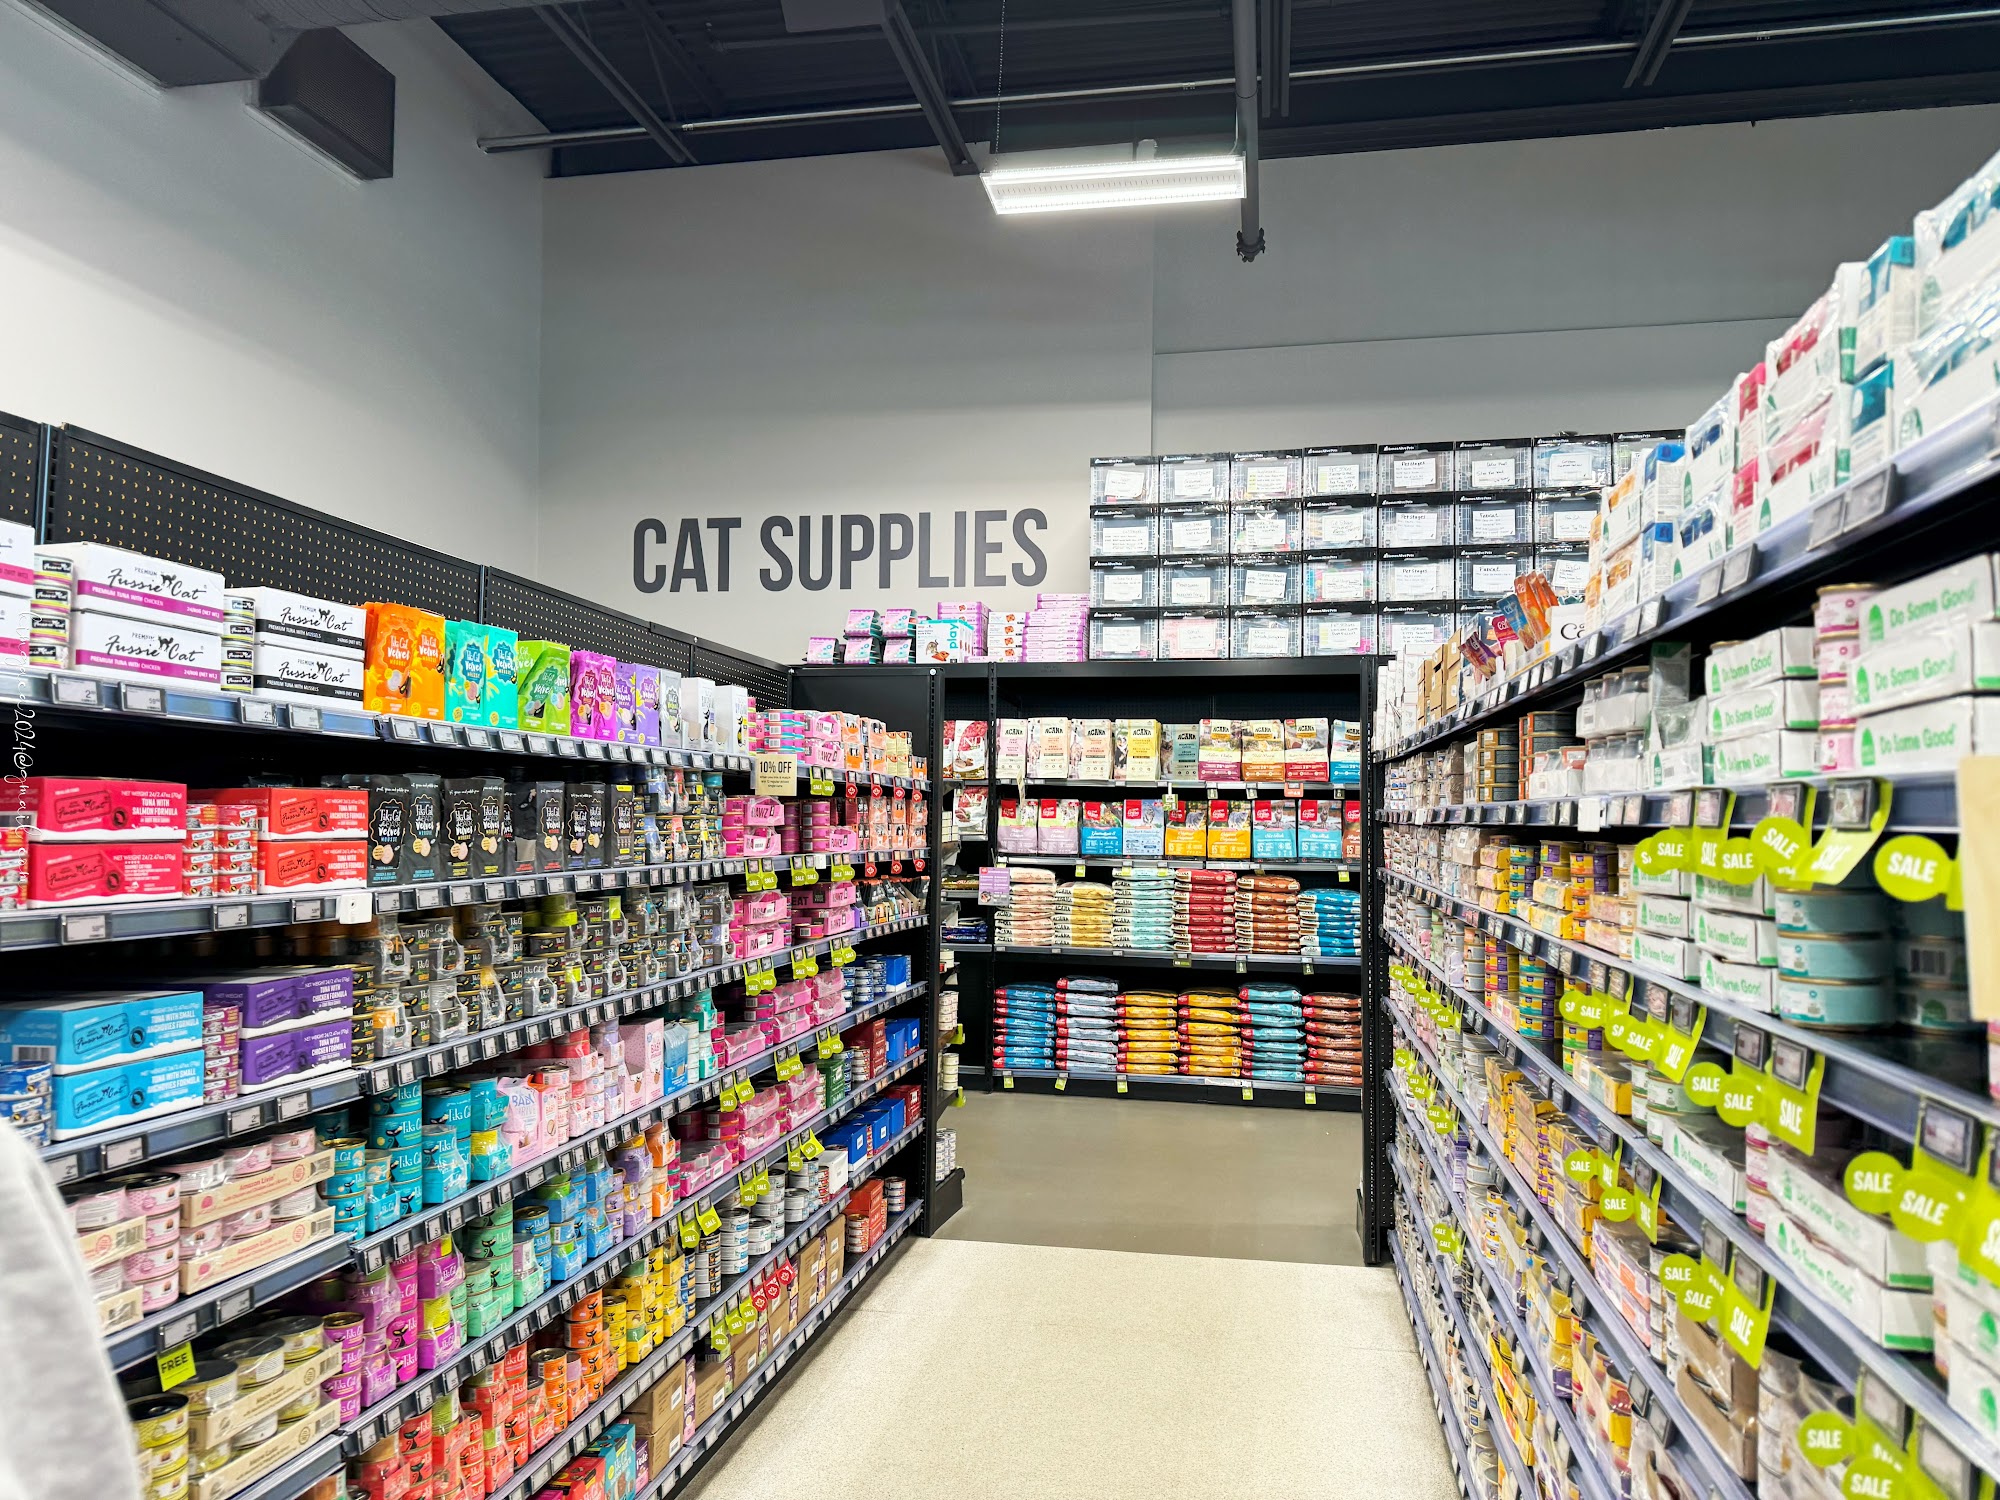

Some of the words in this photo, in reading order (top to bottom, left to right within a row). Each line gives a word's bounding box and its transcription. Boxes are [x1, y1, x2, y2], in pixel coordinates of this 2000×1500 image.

[633, 517, 741, 594] CAT
[759, 508, 1048, 592] SUPPLIES
[134, 566, 158, 577] PREMIUM
[107, 567, 162, 593] Fussie
[170, 580, 207, 600] Cat
[92, 586, 116, 598] PREMIUM
[116, 590, 130, 600] TUNA
[130, 593, 144, 603] WITH
[144, 596, 164, 607] CHICKEN
[299, 604, 317, 613] PREMIUM
[1890, 607, 1904, 626] Do
[1908, 600, 1938, 621] Some
[1941, 585, 1974, 611] Good
[280, 606, 321, 625] Fussie
[326, 614, 353, 632] Cat
[268, 624, 286, 632] PREMIUM
[286, 626, 296, 634] TUNA
[296, 628, 306, 636] WITH
[306, 630, 322, 638] MUSSELS
[949, 623, 959, 650] play
[104, 634, 160, 658] Fussie
[168, 643, 204, 662] Cat
[419, 645, 439, 658] Velvet
[90, 655, 114, 665] PREMIUM
[114, 658, 128, 666] TUNA
[128, 660, 141, 668] WITH
[141, 662, 162, 672] CHICKEN
[1751, 655, 1771, 674] Good
[278, 661, 318, 681] Fussie
[324, 668, 350, 683] Cat
[1874, 671, 1888, 691] Do
[1891, 664, 1920, 684] Some
[1922, 653, 1956, 678] Good
[266, 680, 284, 688] PREMIUM
[284, 682, 294, 690] TUNA
[1725, 711, 1734, 724] Do
[1735, 708, 1753, 723] Some
[1754, 702, 1773, 719] Good
[1880, 732, 1892, 748] Do
[1892, 731, 1920, 748] Some
[1922, 726, 1955, 746] Good
[760, 761, 776, 773] 10%
[778, 761, 792, 774] OFF
[131, 790, 148, 798] WEIGHT
[142, 798, 156, 807] TUNA
[156, 799, 170, 807] WITH
[338, 804, 348, 812] TUNA
[132, 806, 154, 816] SALMON
[154, 807, 178, 816] FORMULA
[348, 812, 366, 820] FORMULA
[378, 827, 400, 836] Velvet
[1658, 842, 1684, 858] SALE
[1763, 827, 1800, 860] SALE
[337, 854, 346, 862] TUNA
[1701, 842, 1717, 868] SALE
[1722, 853, 1754, 870] SALE
[1887, 854, 1938, 884] SALE
[795, 967, 805, 975] SALE
[331, 984, 341, 992] WITH
[747, 984, 759, 992] SALE
[312, 994, 329, 1002] CHICKEN
[329, 991, 348, 1000] FORMULA
[1419, 995, 1431, 1003] SALE
[151, 1014, 166, 1024] TUNA
[166, 1012, 179, 1022] WITH
[179, 1010, 196, 1021] SMALL
[1438, 1014, 1449, 1023] SALE
[1580, 1006, 1601, 1019] SALE
[147, 1022, 176, 1034] ANCHOVIES
[176, 1018, 199, 1030] FORMULA
[330, 1036, 340, 1045] WITH
[1626, 1031, 1653, 1052] SALE
[312, 1048, 328, 1056] CHICKEN
[328, 1045, 346, 1054] FORMULA
[152, 1074, 166, 1084] TUNA
[166, 1072, 179, 1082] WITH
[179, 1070, 196, 1080] SMALL
[780, 1068, 790, 1076] SALE
[148, 1082, 176, 1094] ANCHOVIES
[176, 1078, 200, 1089] FORMULA
[1414, 1086, 1425, 1094] SALE
[1692, 1077, 1720, 1092] SALE
[398, 1086, 412, 1100] Tiki
[741, 1088, 752, 1096] SALE
[724, 1100, 734, 1108] SALE
[1724, 1092, 1753, 1111] SALE
[448, 1109, 463, 1122] Tiki
[1428, 1110, 1440, 1118] SALE
[1779, 1098, 1803, 1135] SALE
[402, 1120, 415, 1134] Tiki
[1436, 1121, 1448, 1129] SALE
[438, 1140, 451, 1153] Tiki
[398, 1156, 412, 1168] Tiki
[1570, 1160, 1591, 1173] SALE
[1602, 1164, 1613, 1187] SALE
[1853, 1171, 1893, 1193] SALE
[239, 1179, 260, 1192] Amazon
[1604, 1198, 1627, 1211] SALE
[1900, 1190, 1949, 1226] SALE
[1640, 1201, 1651, 1228] SALE
[705, 1219, 716, 1229] SALE
[685, 1235, 697, 1243] SALE
[237, 1244, 259, 1255] Amazon
[1664, 1267, 1692, 1281] SALE
[1684, 1292, 1712, 1309] SALE
[1730, 1306, 1754, 1346] SALE
[160, 1352, 188, 1375] FREE
[1806, 1429, 1842, 1450] SALE
[1850, 1474, 1893, 1498] SALE
